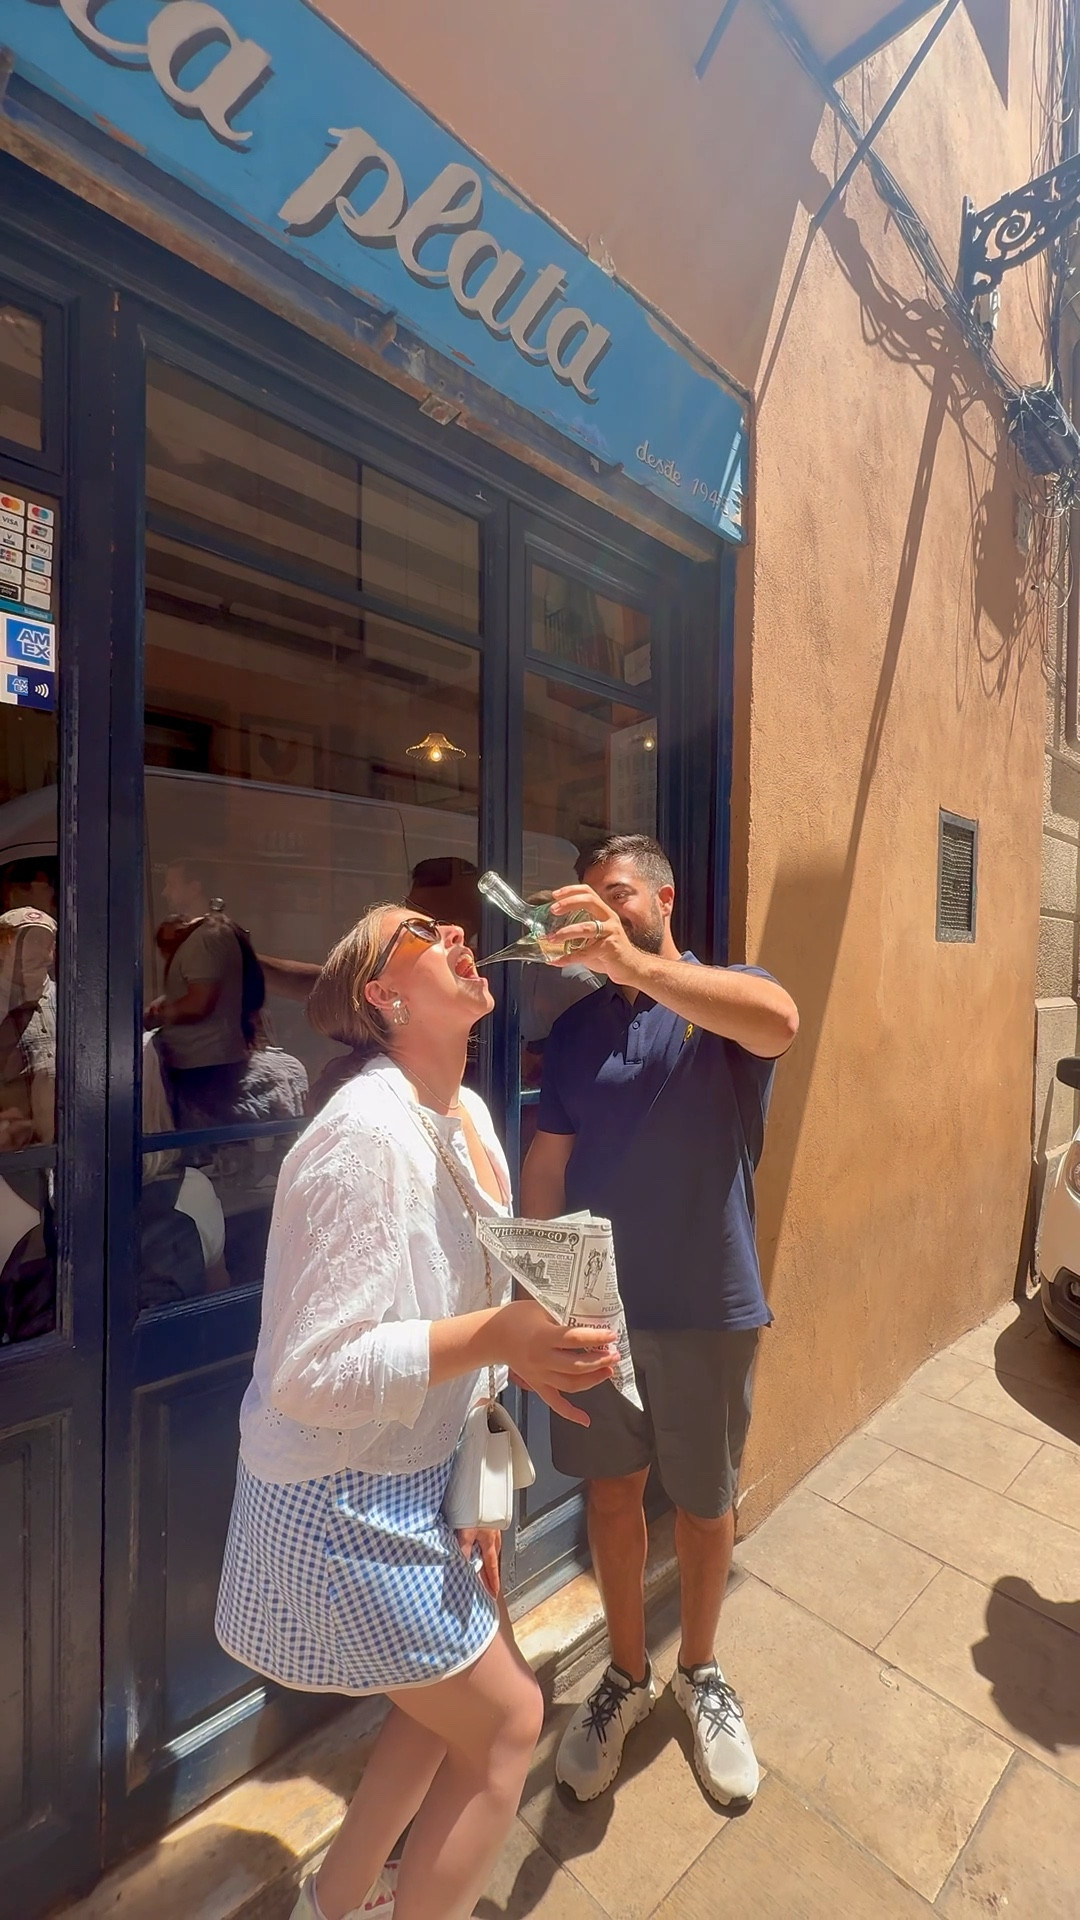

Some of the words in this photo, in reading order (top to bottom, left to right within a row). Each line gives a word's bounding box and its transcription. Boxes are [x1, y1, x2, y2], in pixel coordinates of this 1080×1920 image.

[277, 127, 612, 398] plata
[636, 440, 681, 487] desde
[2, 515, 19, 527] VISA
[17, 628, 50, 647] AM
